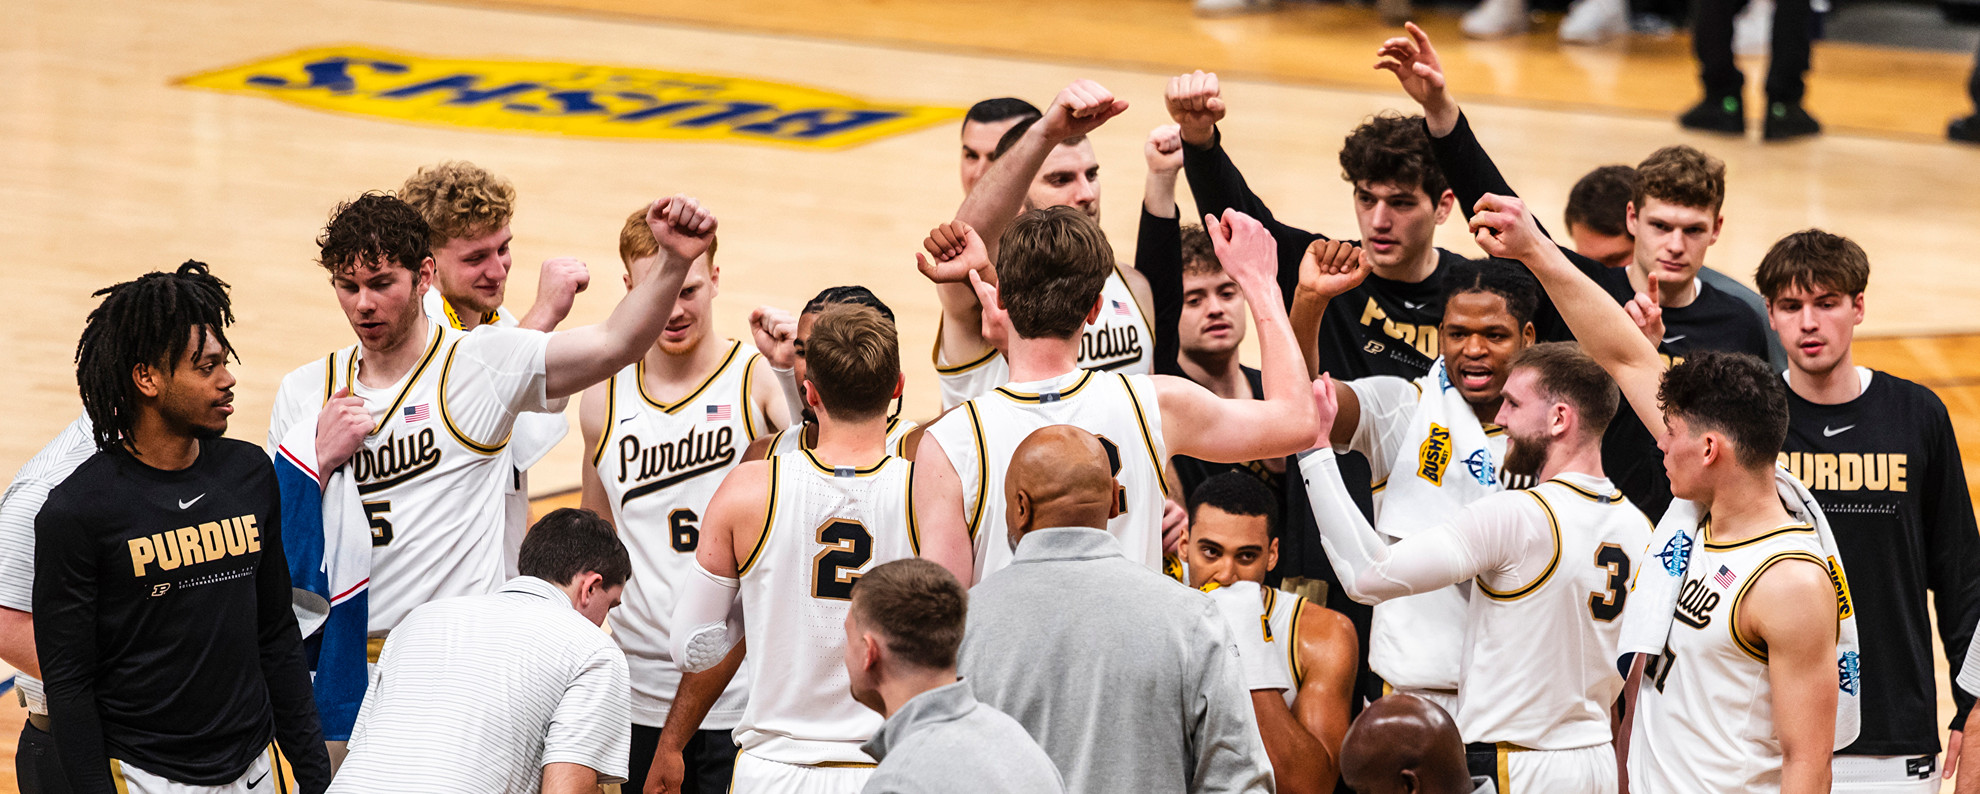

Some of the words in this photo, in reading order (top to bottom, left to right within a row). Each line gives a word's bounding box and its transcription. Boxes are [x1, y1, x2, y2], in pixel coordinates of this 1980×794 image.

[1077, 322, 1142, 362] rdue
[1360, 296, 1439, 361] PURD
[351, 427, 441, 483] urdue
[617, 424, 736, 485] Purdue
[1421, 427, 1449, 483] BUSH'S
[1439, 449, 1449, 465] BEST
[127, 513, 262, 577] PURDUE
[667, 507, 699, 553] 6
[811, 517, 874, 600] 2
[1588, 541, 1631, 623] 3
